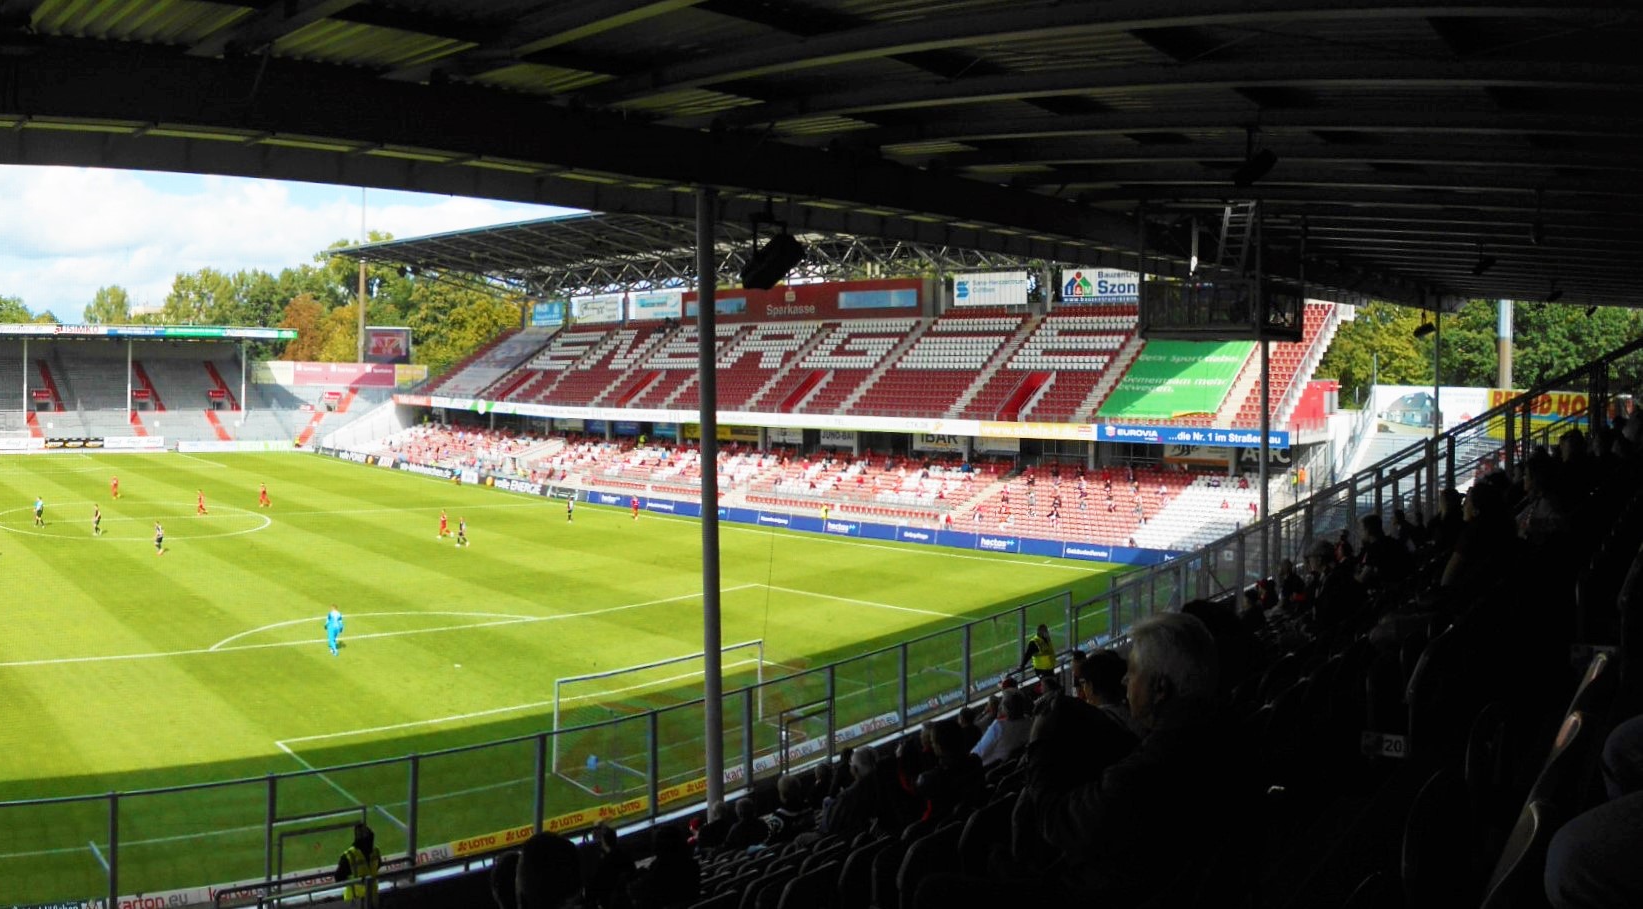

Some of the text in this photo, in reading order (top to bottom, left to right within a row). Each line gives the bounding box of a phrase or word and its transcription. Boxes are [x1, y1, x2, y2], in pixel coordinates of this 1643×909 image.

[1098, 271, 1138, 279] Bauzentru
[1098, 280, 1136, 294] Szon
[766, 303, 816, 316] Sparkasse
[1116, 428, 1158, 438] EUROVIA
[1193, 432, 1206, 442] Nr.
[1215, 432, 1227, 443] im
[558, 813, 584, 828] LOTTO
[468, 835, 496, 848] LOTTO
